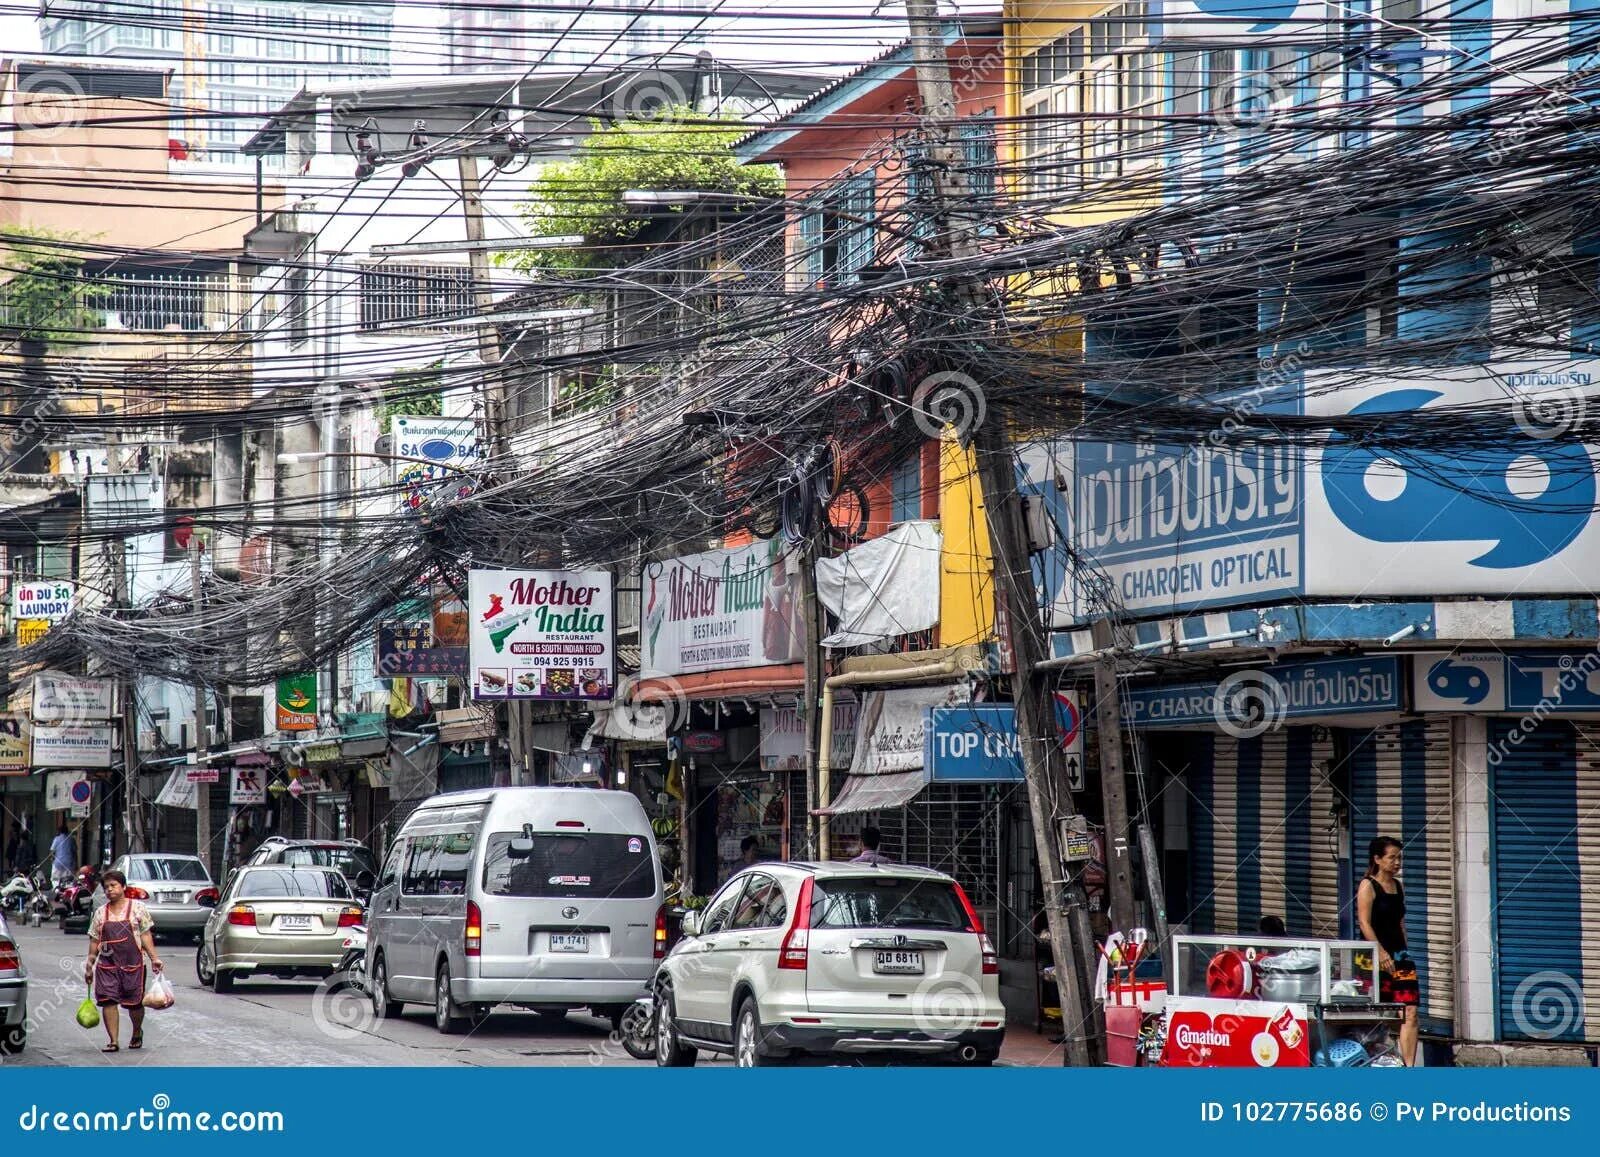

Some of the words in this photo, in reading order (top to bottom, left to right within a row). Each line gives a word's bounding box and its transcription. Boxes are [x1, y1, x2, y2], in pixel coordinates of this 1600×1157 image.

[1122, 561, 1203, 600] CHAROEN
[1211, 547, 1292, 588] OPTICAL
[510, 578, 600, 605] Mother
[669, 565, 720, 622] Mother
[20, 602, 69, 615] LAUNDRY
[535, 605, 604, 633] India
[693, 620, 737, 639] RESTAURANT
[513, 643, 535, 654] NORTH
[541, 643, 561, 654] SOUTH
[563, 643, 584, 654] INDIAN
[585, 643, 601, 654] FOOD
[681, 649, 696, 664] NORTH
[701, 648, 716, 662] SOUTH
[534, 656, 550, 666] 094
[553, 656, 570, 666] 925
[572, 656, 594, 666] 9915
[937, 732, 978, 758] TOP
[567, 935, 586, 945] 1741
[896, 952, 919, 964] 6811
[1176, 1024, 1230, 1049] Carnation
